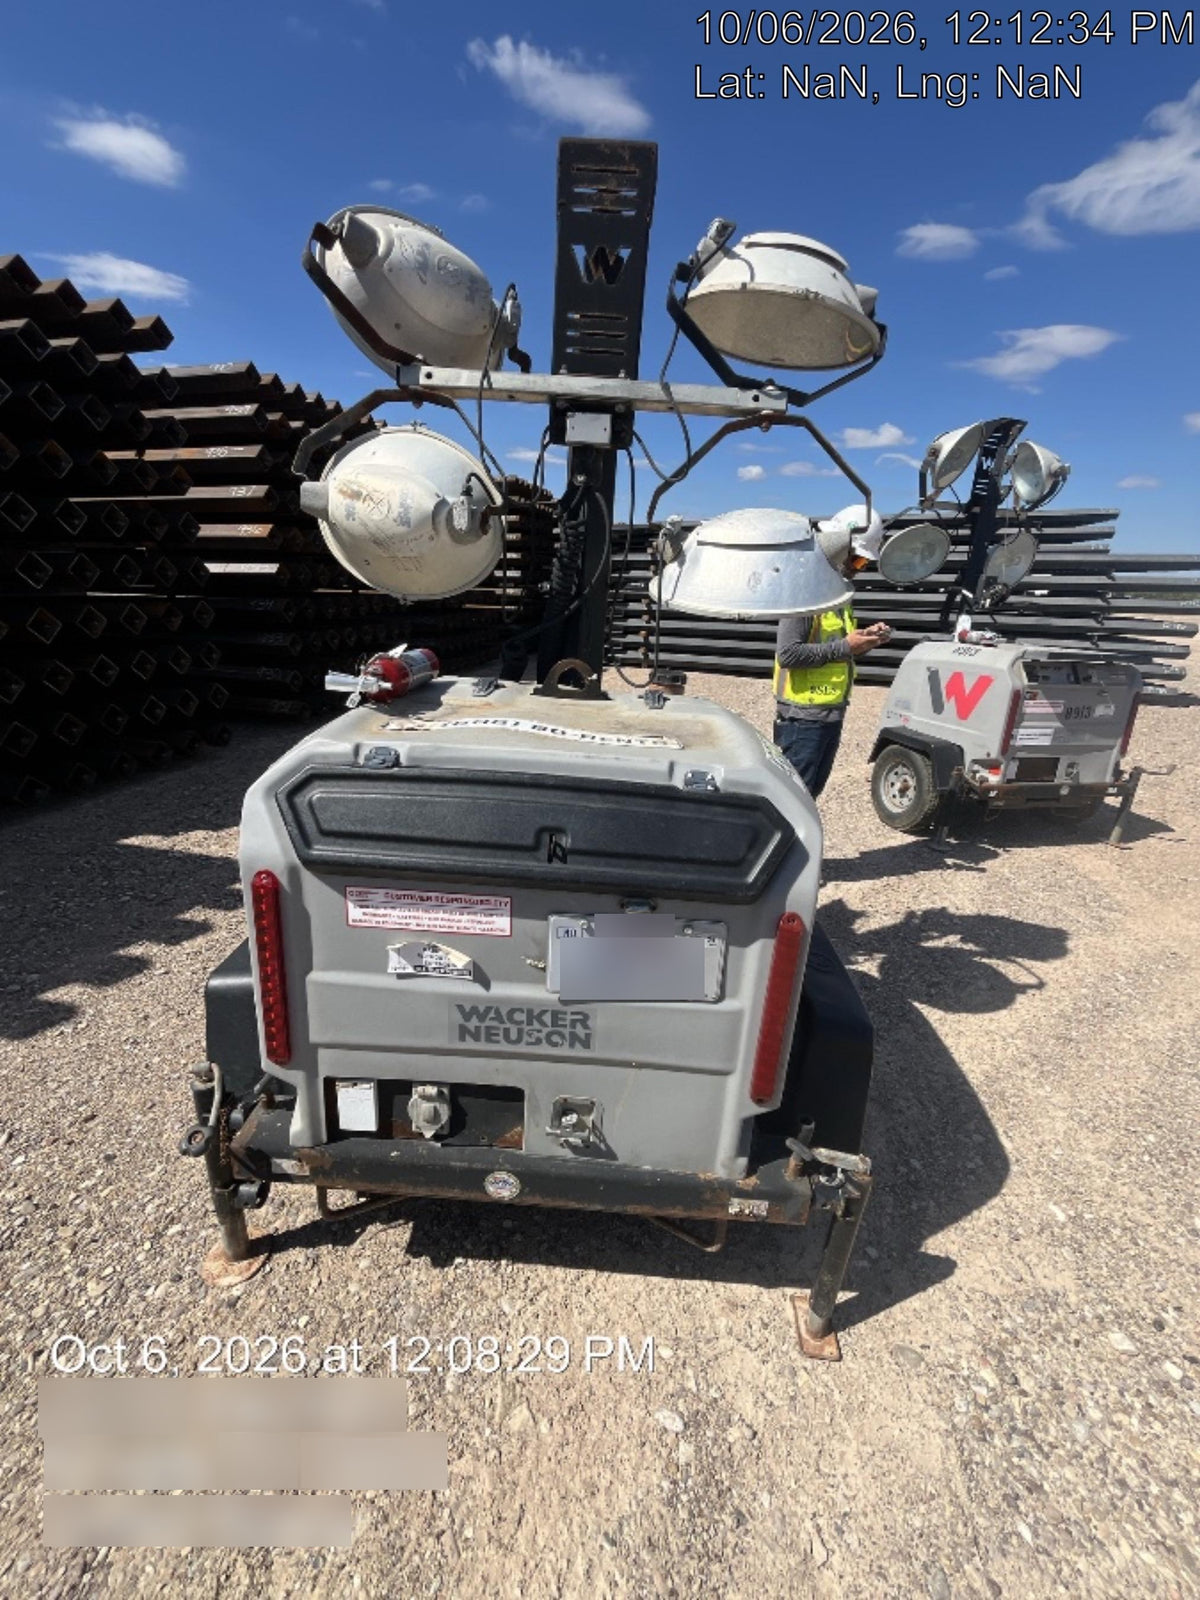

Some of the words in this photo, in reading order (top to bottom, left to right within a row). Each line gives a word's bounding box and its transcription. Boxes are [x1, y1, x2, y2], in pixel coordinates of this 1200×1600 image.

[571, 244, 632, 286] W
[456, 1004, 591, 1030] WACKER
[458, 1024, 592, 1050] NEUSON
